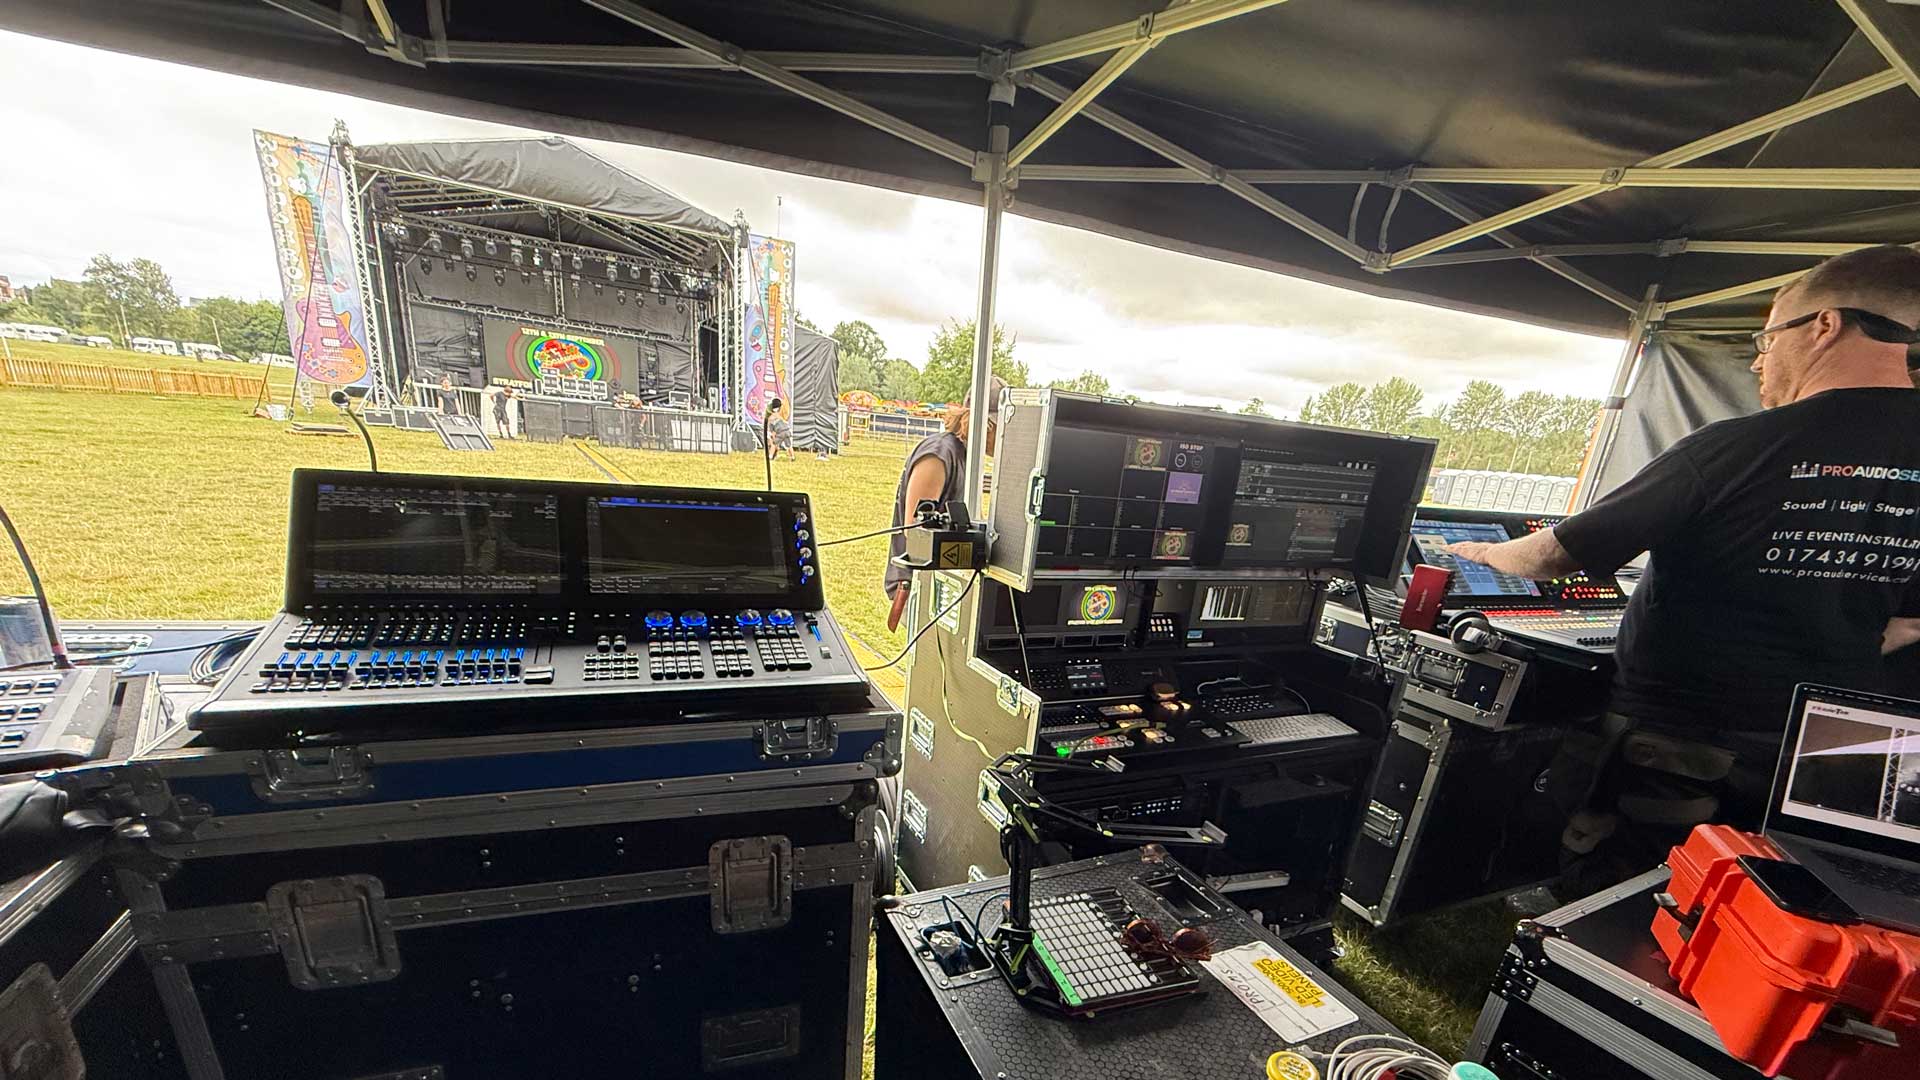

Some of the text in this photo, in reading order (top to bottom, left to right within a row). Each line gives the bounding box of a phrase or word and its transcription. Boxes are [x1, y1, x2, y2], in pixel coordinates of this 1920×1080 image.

[1821, 465, 1920, 482] PROAUDIOSE
[1781, 500, 1826, 510] Sound
[1874, 503, 1915, 516] Stage
[1772, 531, 1803, 540] LIVE
[1807, 531, 1854, 543] EVENTS
[1261, 958, 1321, 1006] LED VIDEO
[1278, 960, 1324, 996] PANELS
